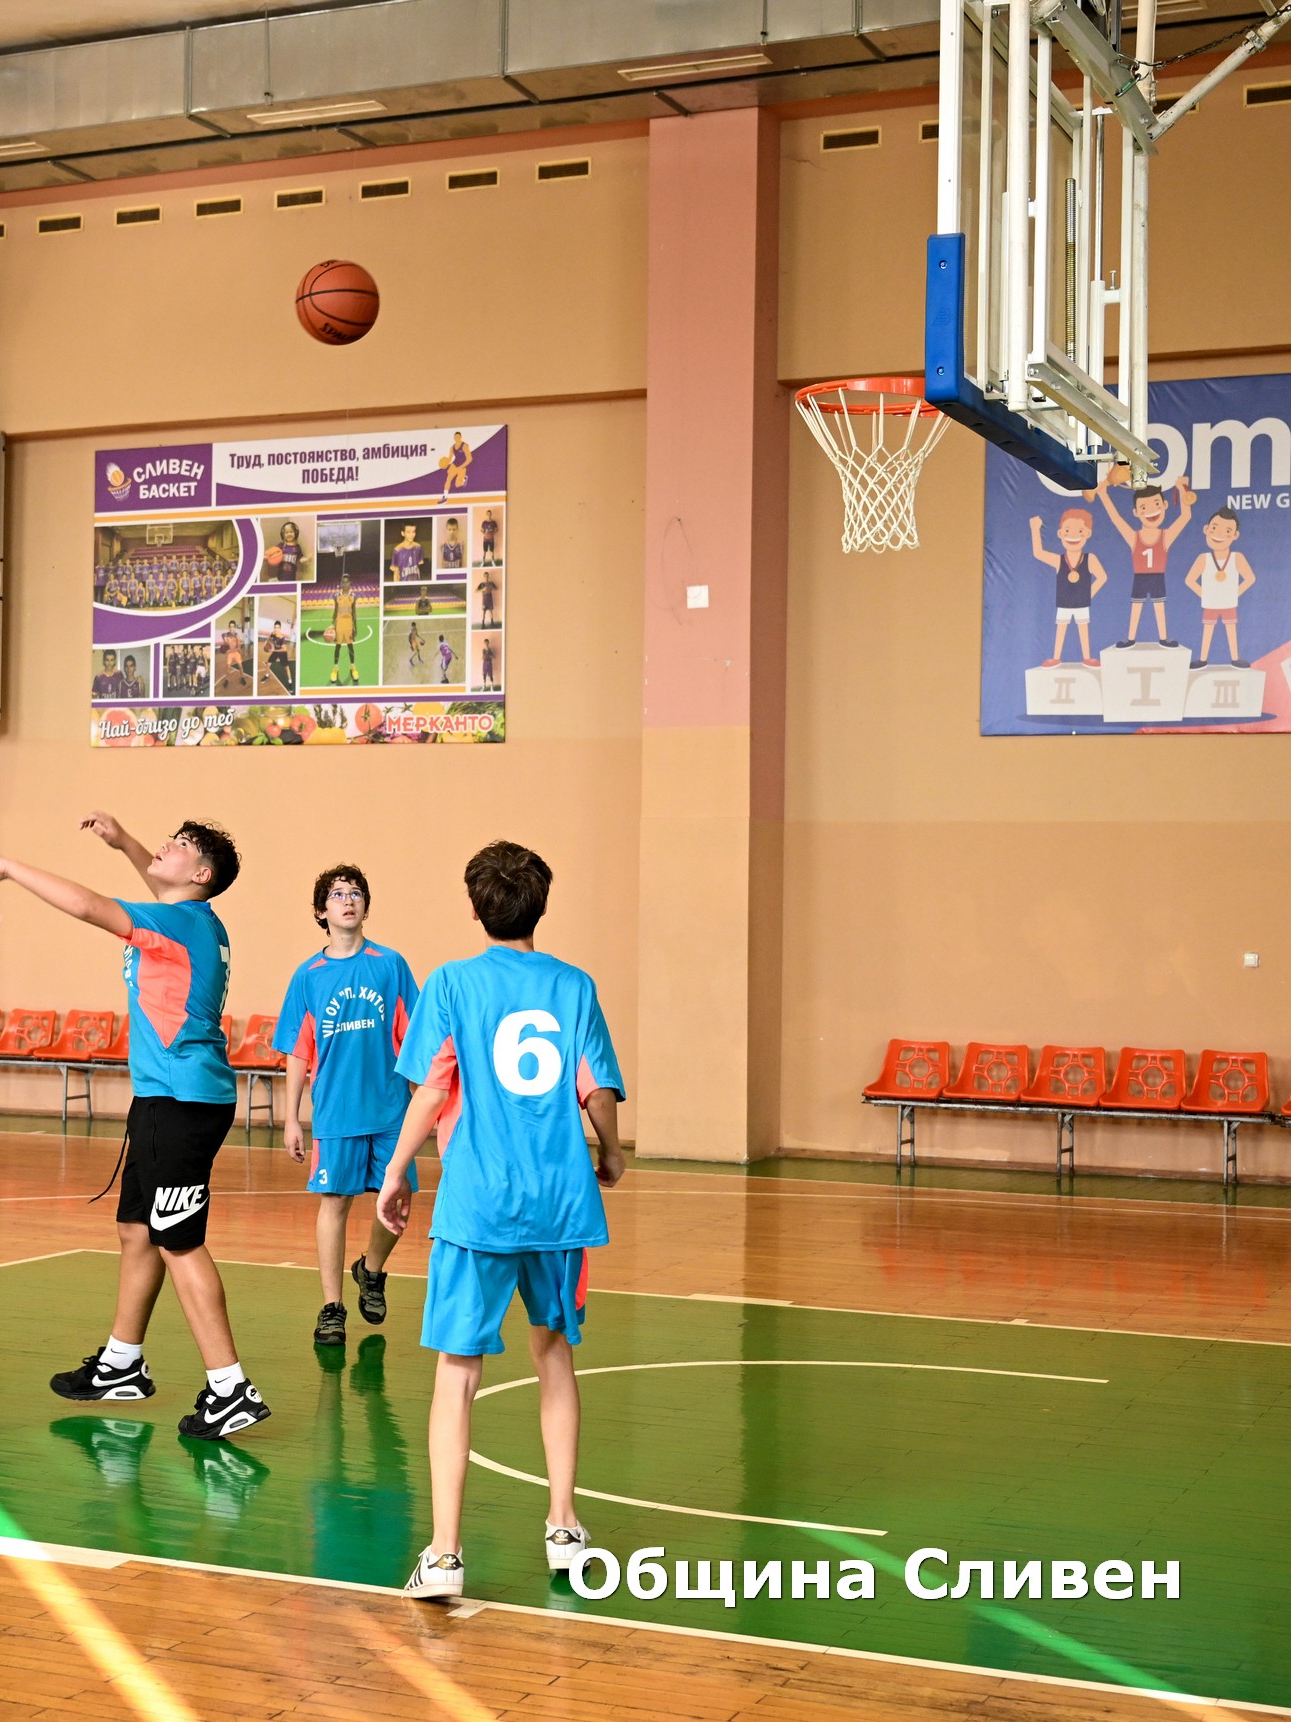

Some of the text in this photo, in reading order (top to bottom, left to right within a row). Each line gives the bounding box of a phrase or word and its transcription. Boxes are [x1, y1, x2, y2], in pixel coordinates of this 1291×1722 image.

[229, 452, 265, 470] Труд,
[267, 447, 357, 467] постоянство,
[362, 443, 428, 463] амбиция
[132, 458, 205, 483] СЛИВЕН
[302, 467, 359, 485] ПОБЕДА!
[139, 482, 198, 499] БАСКЕТ
[1227, 493, 1271, 510] NEW
[1142, 548, 1153, 568] 1
[180, 716, 202, 737] до
[204, 709, 235, 730] теб
[387, 715, 494, 733] МЕРКАНТО
[326, 998, 340, 1016] ОУ
[493, 1009, 562, 1096] 6
[318, 1168, 328, 1185] 3
[155, 1184, 205, 1211] NIKE
